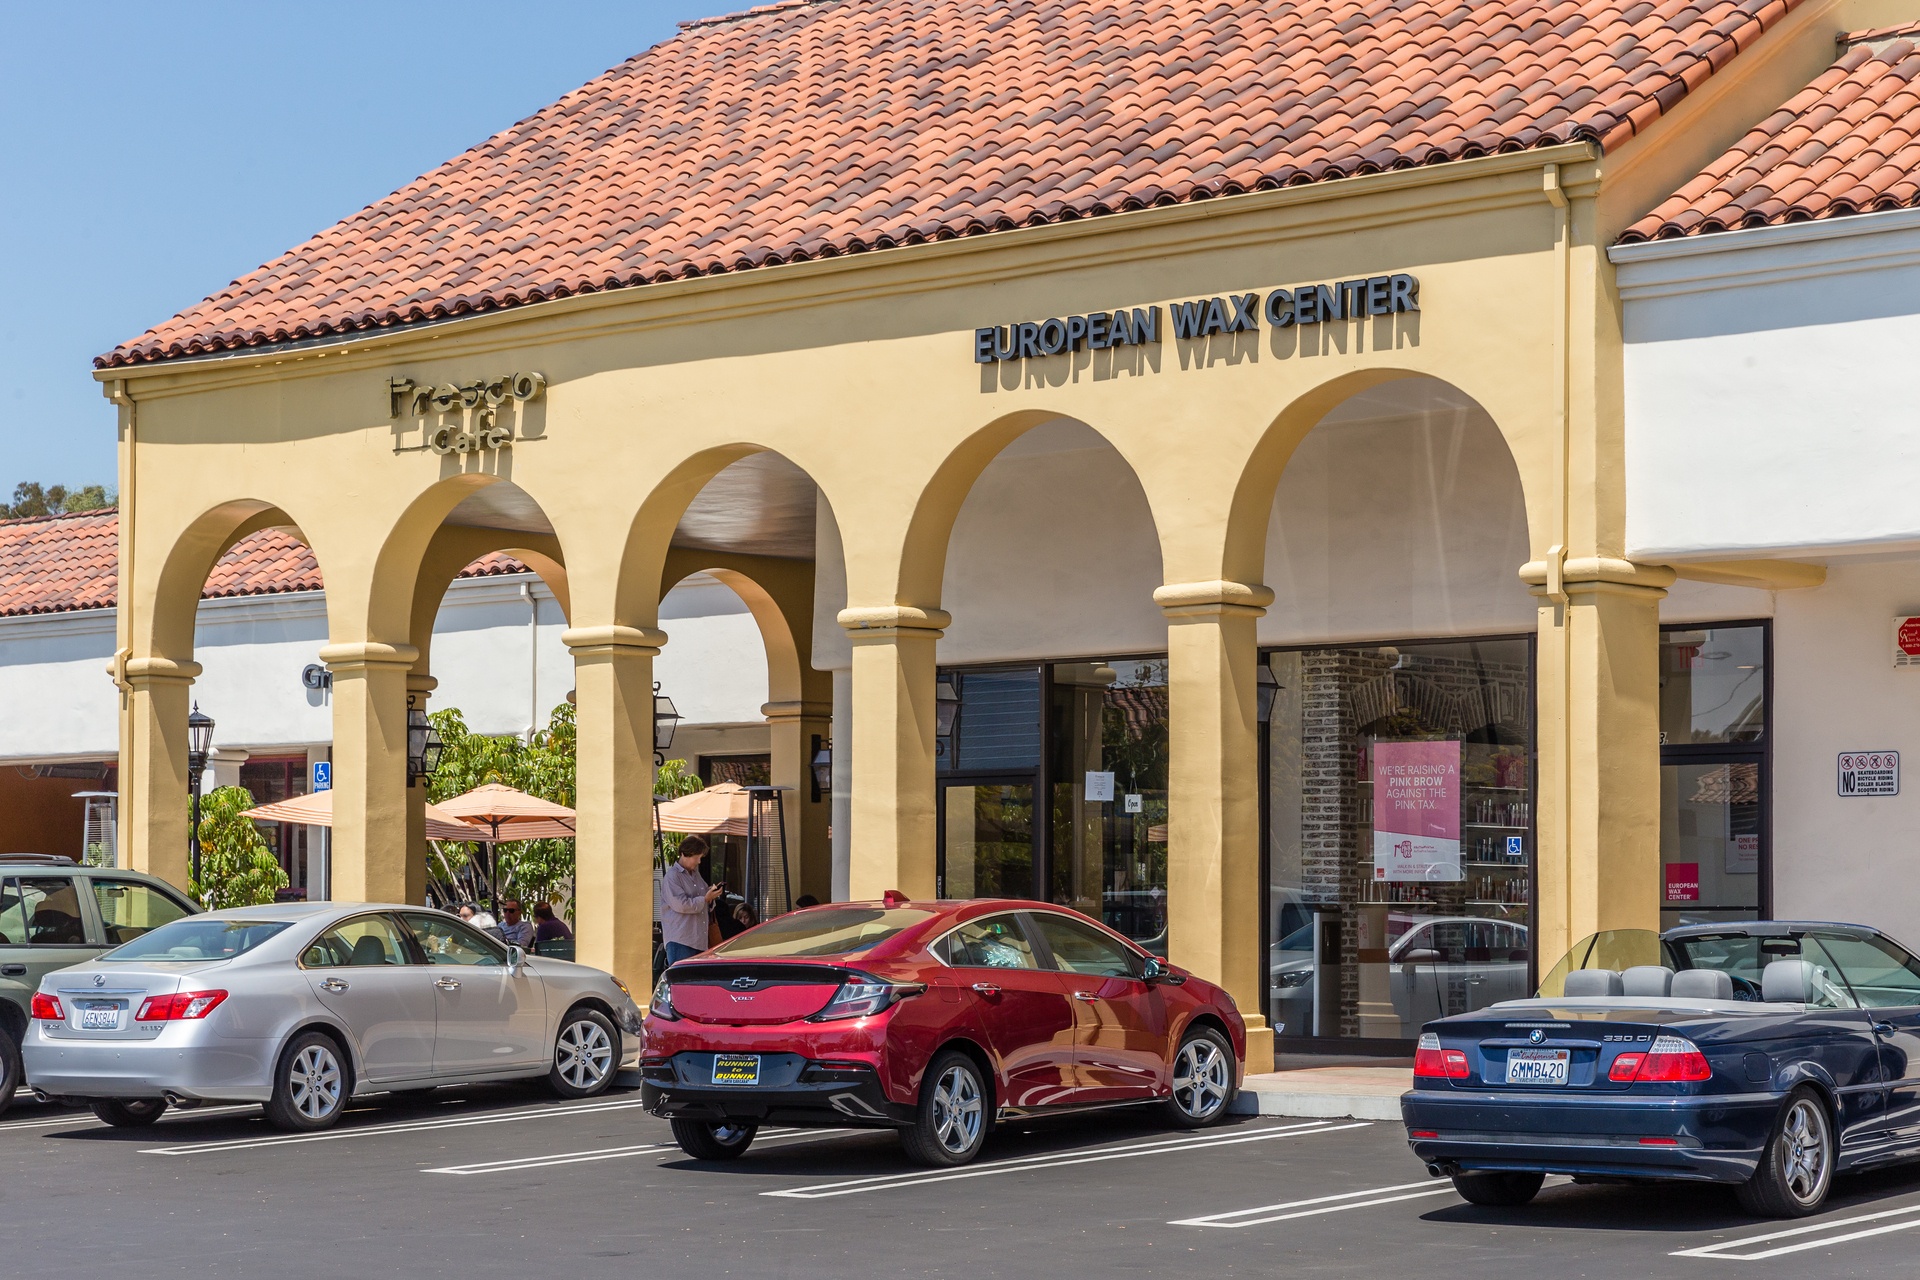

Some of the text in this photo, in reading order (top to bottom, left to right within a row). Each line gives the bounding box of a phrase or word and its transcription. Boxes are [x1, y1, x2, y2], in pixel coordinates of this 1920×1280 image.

[974, 273, 1421, 364] EUROPEAN WAX CENTER
[385, 371, 547, 419] Fresco
[431, 409, 512, 456] Cafe
[1378, 764, 1454, 776] WE'RE RAISING A
[1390, 776, 1443, 786] PINK BROW
[1842, 771, 1856, 793] NO
[1386, 788, 1446, 798] AGAINST THE
[1395, 800, 1437, 810] PINK TAX.
[730, 994, 755, 1002] VOLT
[84, 1012, 116, 1024] 6ENS844
[1520, 1052, 1556, 1062] California
[1511, 1062, 1564, 1078] 6MMB420
